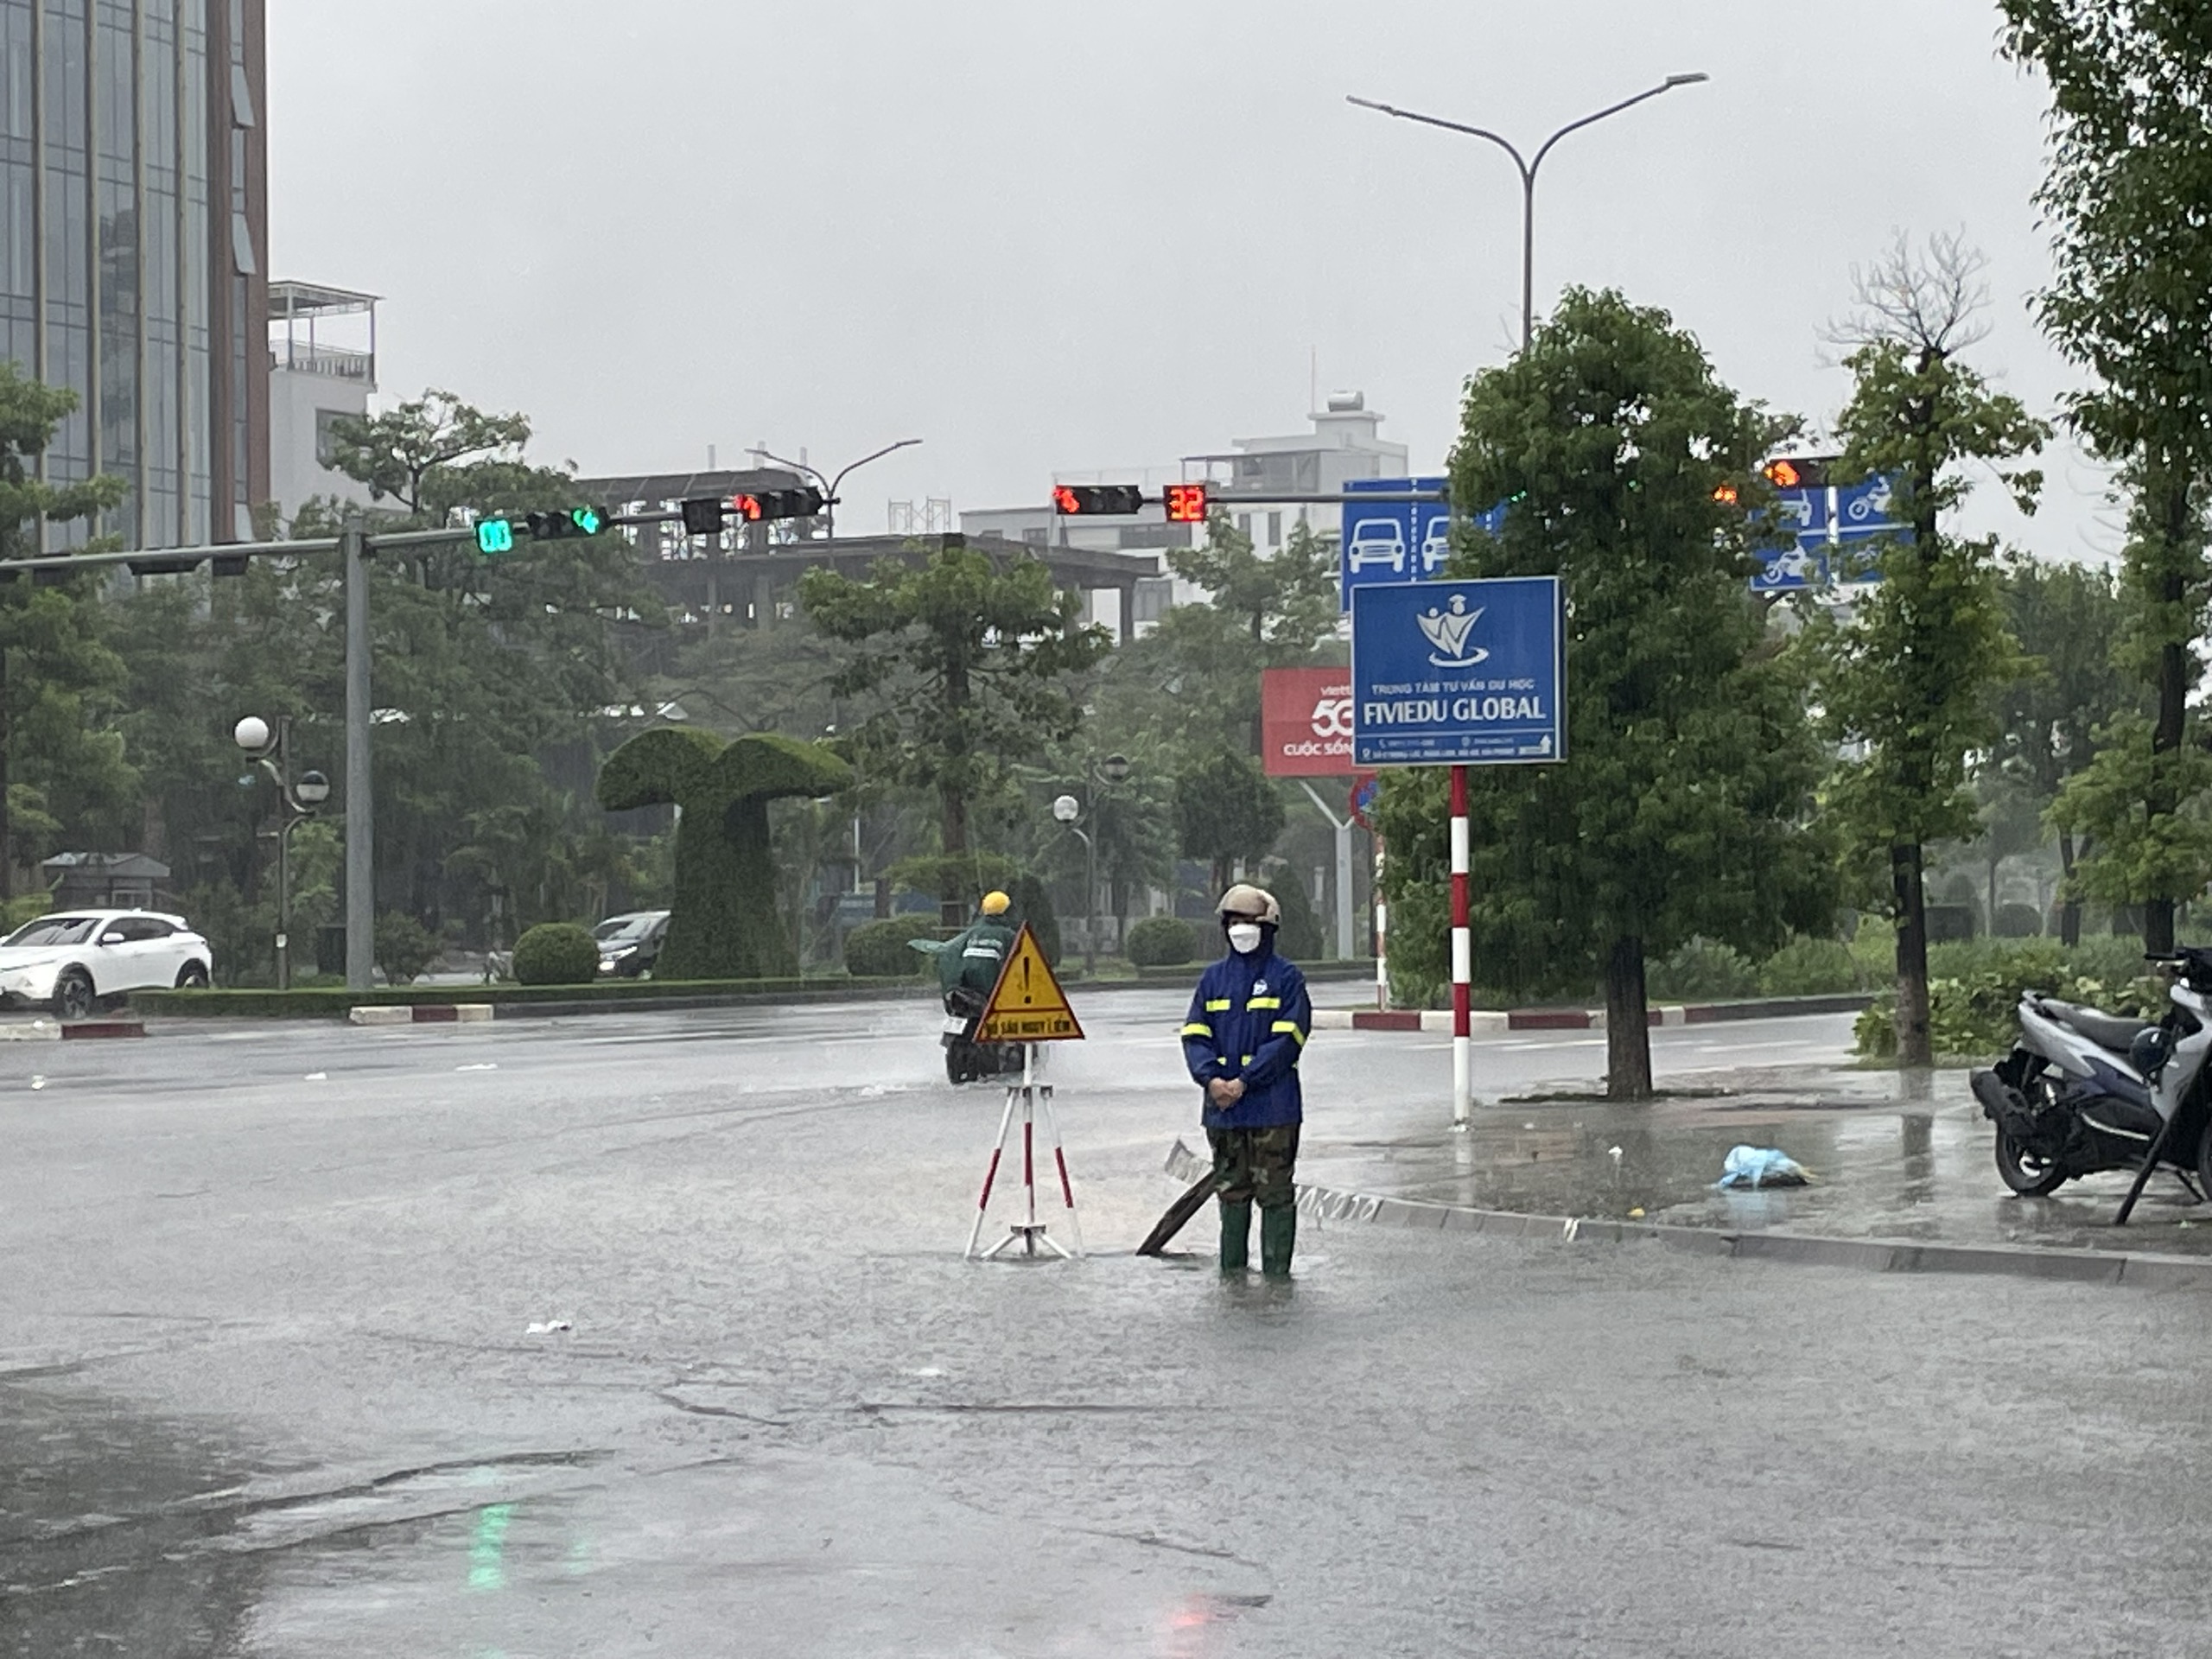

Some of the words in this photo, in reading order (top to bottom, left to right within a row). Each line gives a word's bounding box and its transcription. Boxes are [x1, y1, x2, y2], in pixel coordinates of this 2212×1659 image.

[1170, 486, 1204, 518] 32
[1488, 679, 1506, 691] DU
[1311, 699, 1352, 737] 5G
[1363, 699, 1448, 726] FIVIEDU
[1452, 696, 1547, 721] GLOBAL
